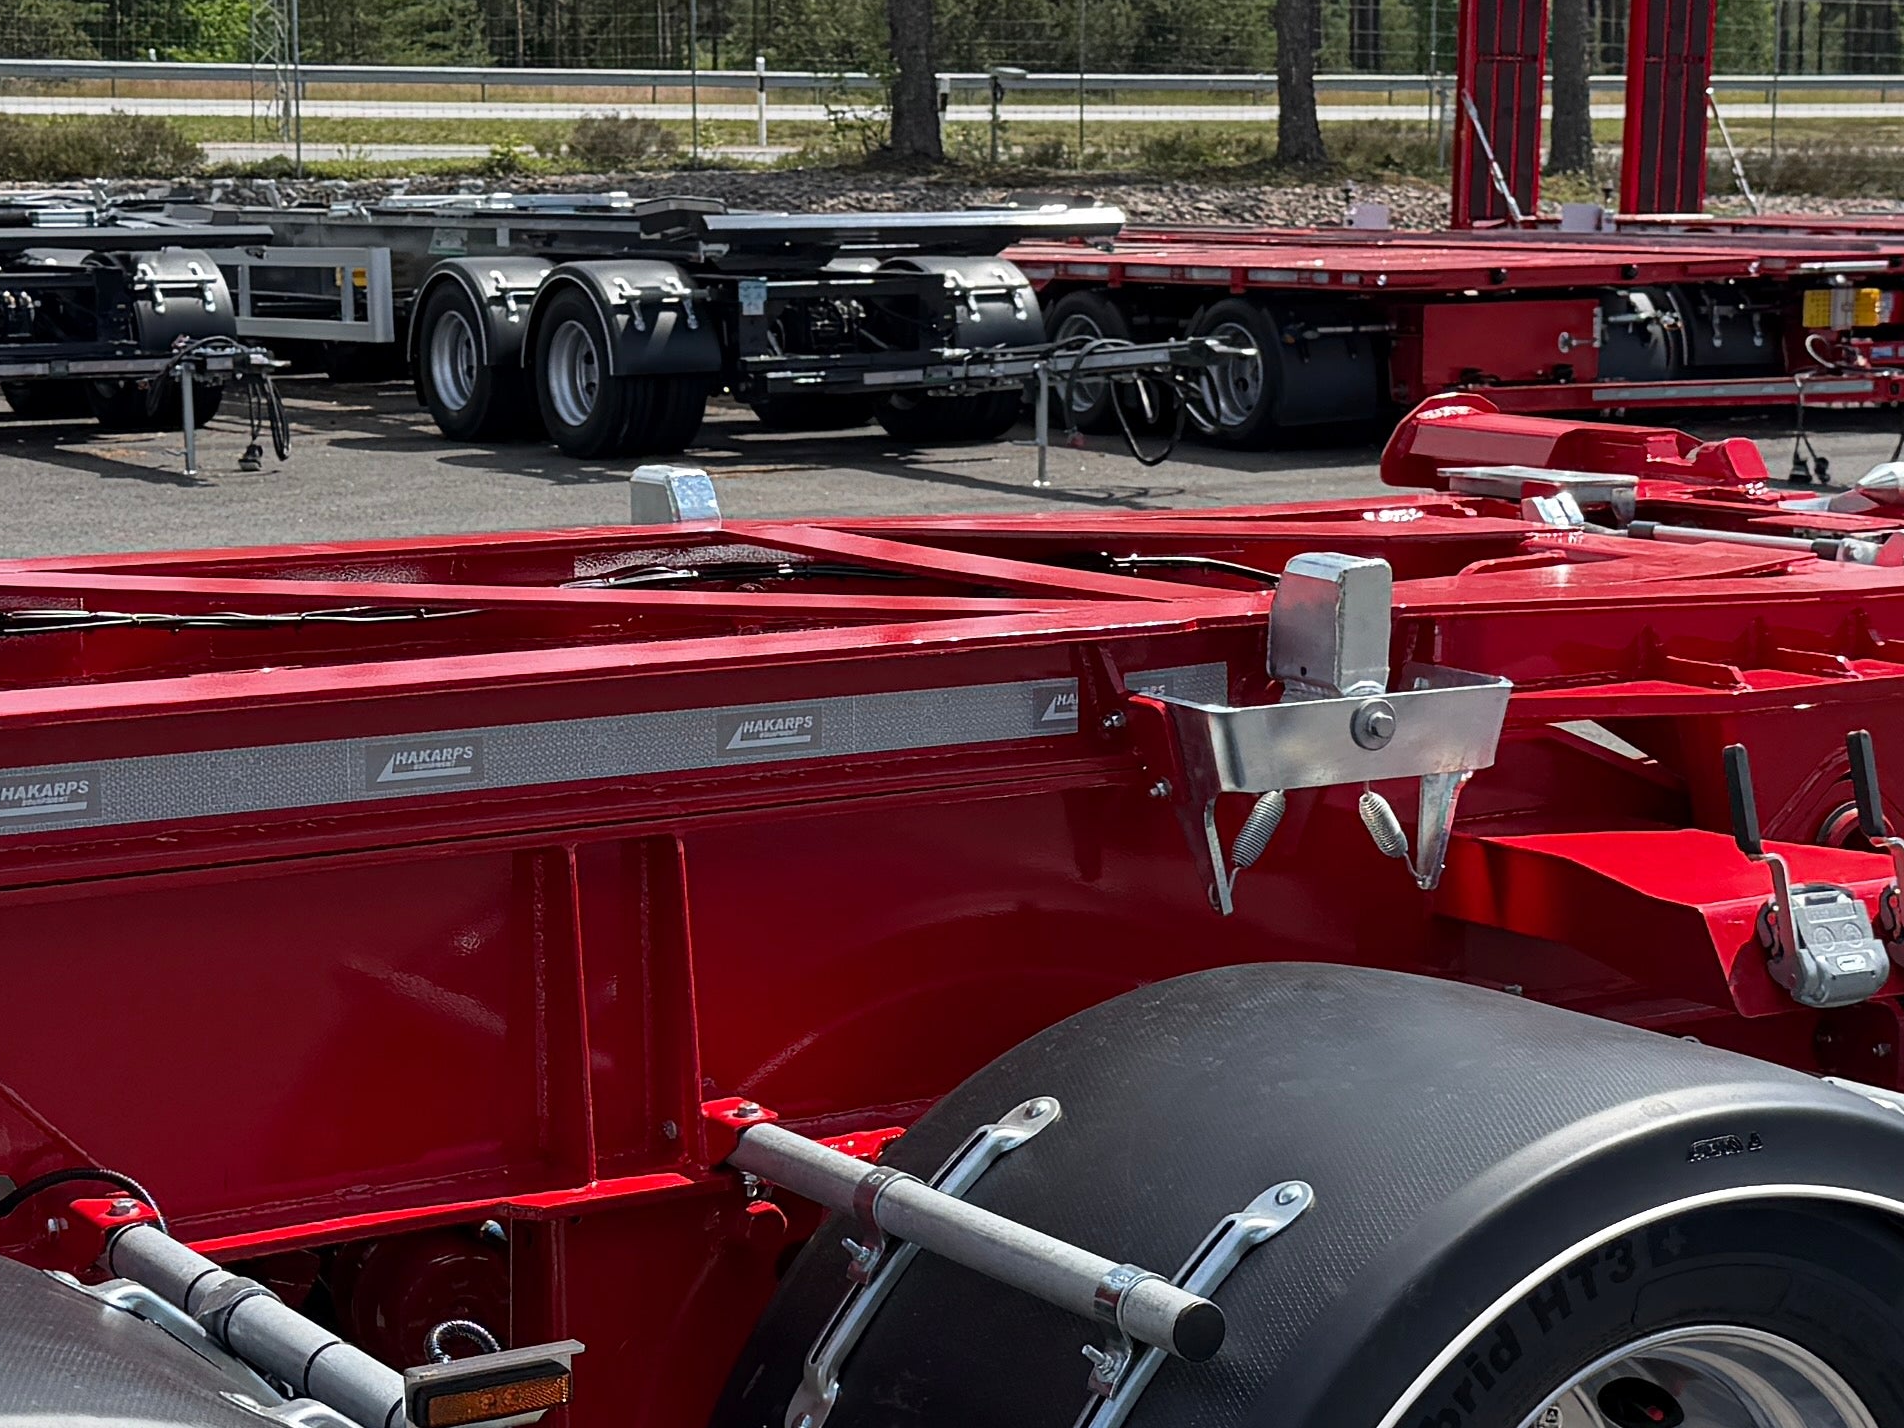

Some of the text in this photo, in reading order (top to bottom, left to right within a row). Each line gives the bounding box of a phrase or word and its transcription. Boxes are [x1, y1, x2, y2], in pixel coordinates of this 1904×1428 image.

[743, 715, 813, 733] HAKARPS
[395, 745, 474, 765] HAKARPS
[0, 779, 89, 801] HAKARPS
